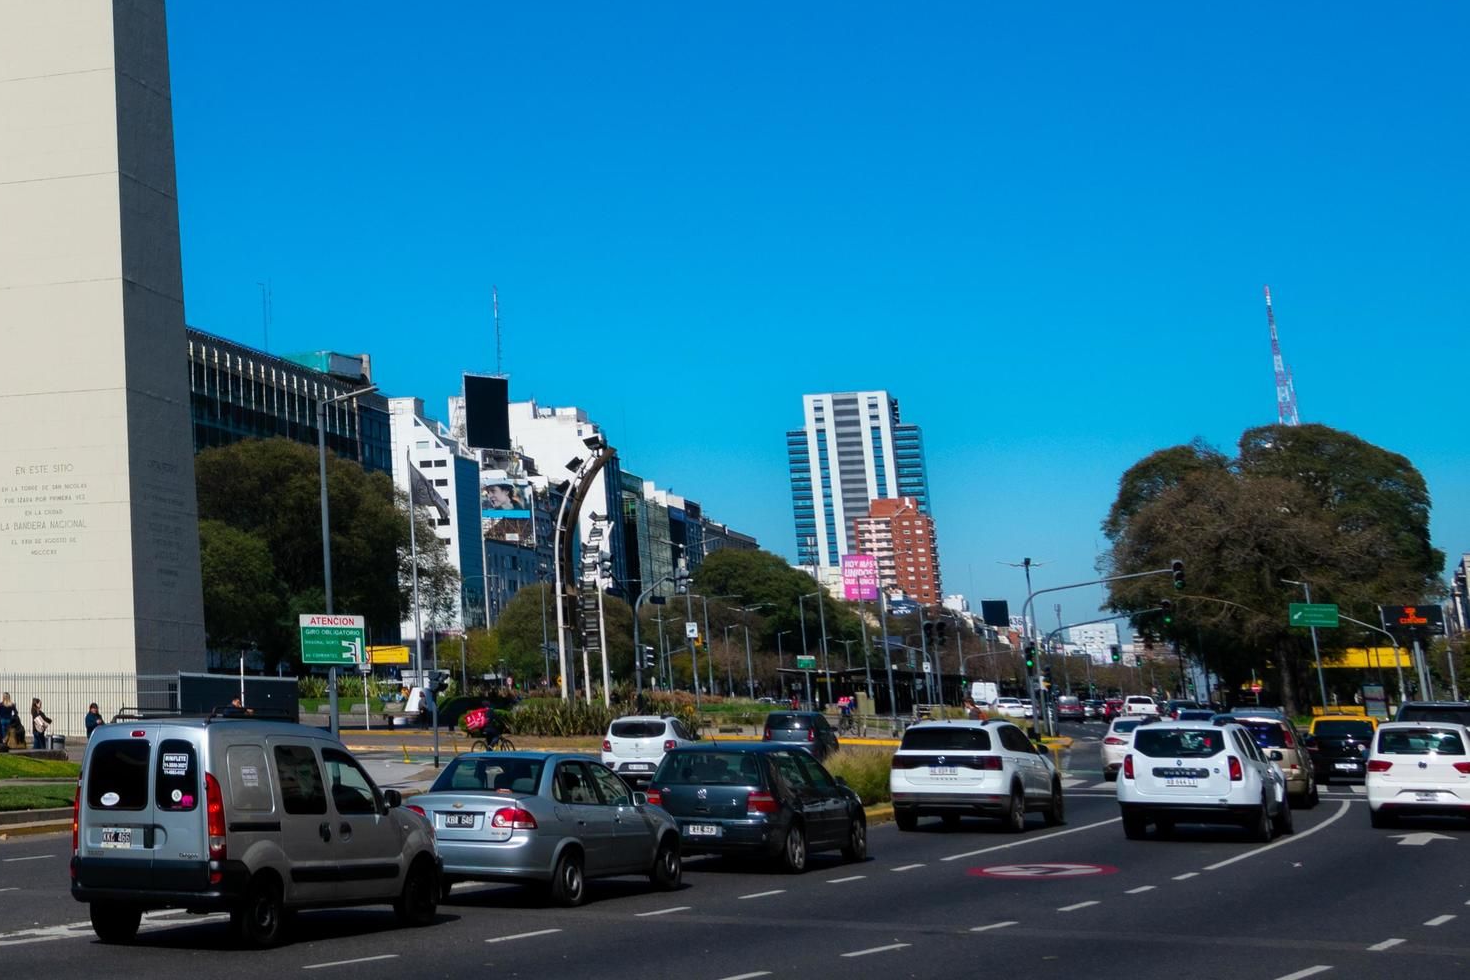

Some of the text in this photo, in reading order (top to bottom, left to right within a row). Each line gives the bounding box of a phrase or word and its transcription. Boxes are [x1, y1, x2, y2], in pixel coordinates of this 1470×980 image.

[16, 463, 74, 475] EN ESTE SITIO
[0, 519, 87, 531] LA BANDERA NACIONAL
[310, 617, 354, 625] ATENCION
